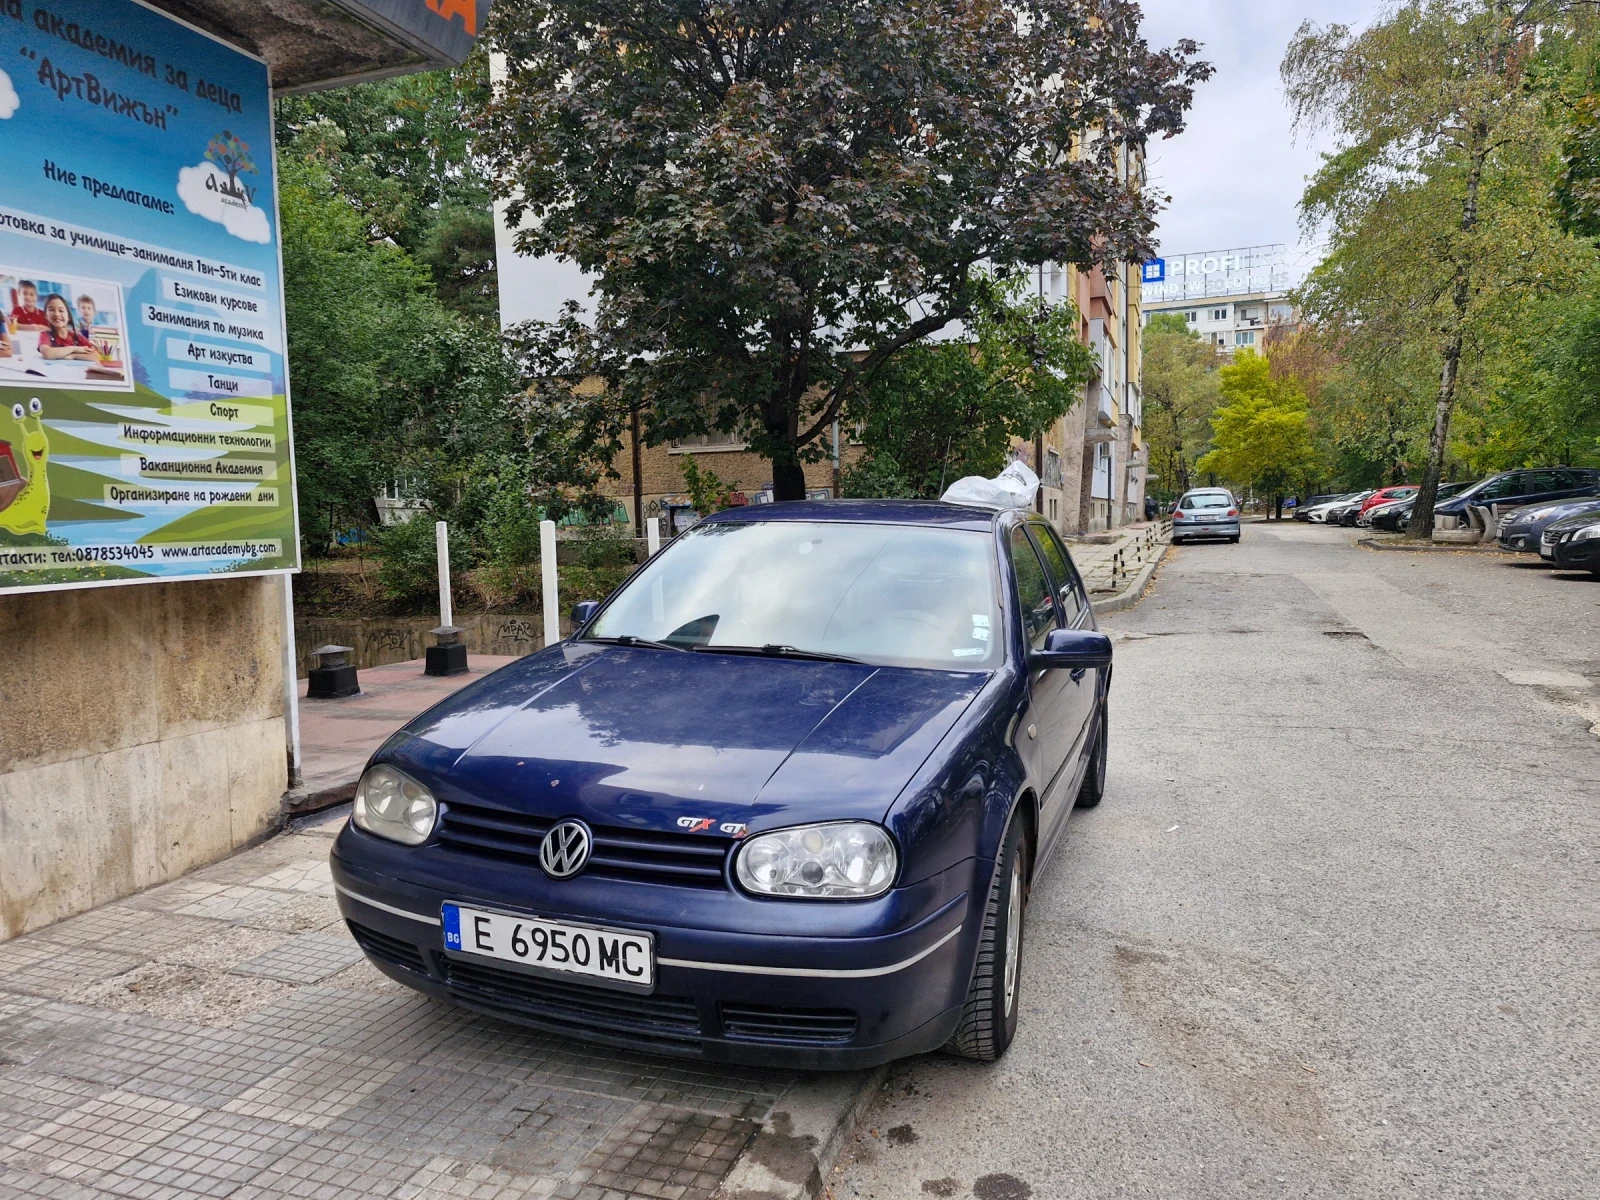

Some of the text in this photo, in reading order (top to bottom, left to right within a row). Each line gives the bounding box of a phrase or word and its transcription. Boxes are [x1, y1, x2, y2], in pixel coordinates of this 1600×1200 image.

[33, 9, 157, 79] академия
[164, 64, 189, 92] за
[196, 78, 242, 115] деца
[43, 159, 174, 216] Ние предлагаме:
[50, 226, 66, 241] за
[196, 259, 238, 282] 1ви-5ти
[240, 272, 262, 287] клас
[174, 282, 258, 313] Езикови курсове
[148, 306, 264, 342] Занимания по музика
[188, 343, 253, 366] Арт изкуства
[208, 375, 239, 393] Танци
[210, 403, 239, 420] Спорт
[123, 425, 272, 448] Информационни технологии
[140, 457, 263, 476] Ваканционна Академия
[110, 486, 274, 505] Организиране на рождени дни
[0, 553, 46, 566] такти:
[162, 542, 277, 558] www.artacademybg.com
[676, 816, 717, 833] GTX
[447, 931, 460, 945] BG
[474, 915, 644, 978] E 6950 MC
